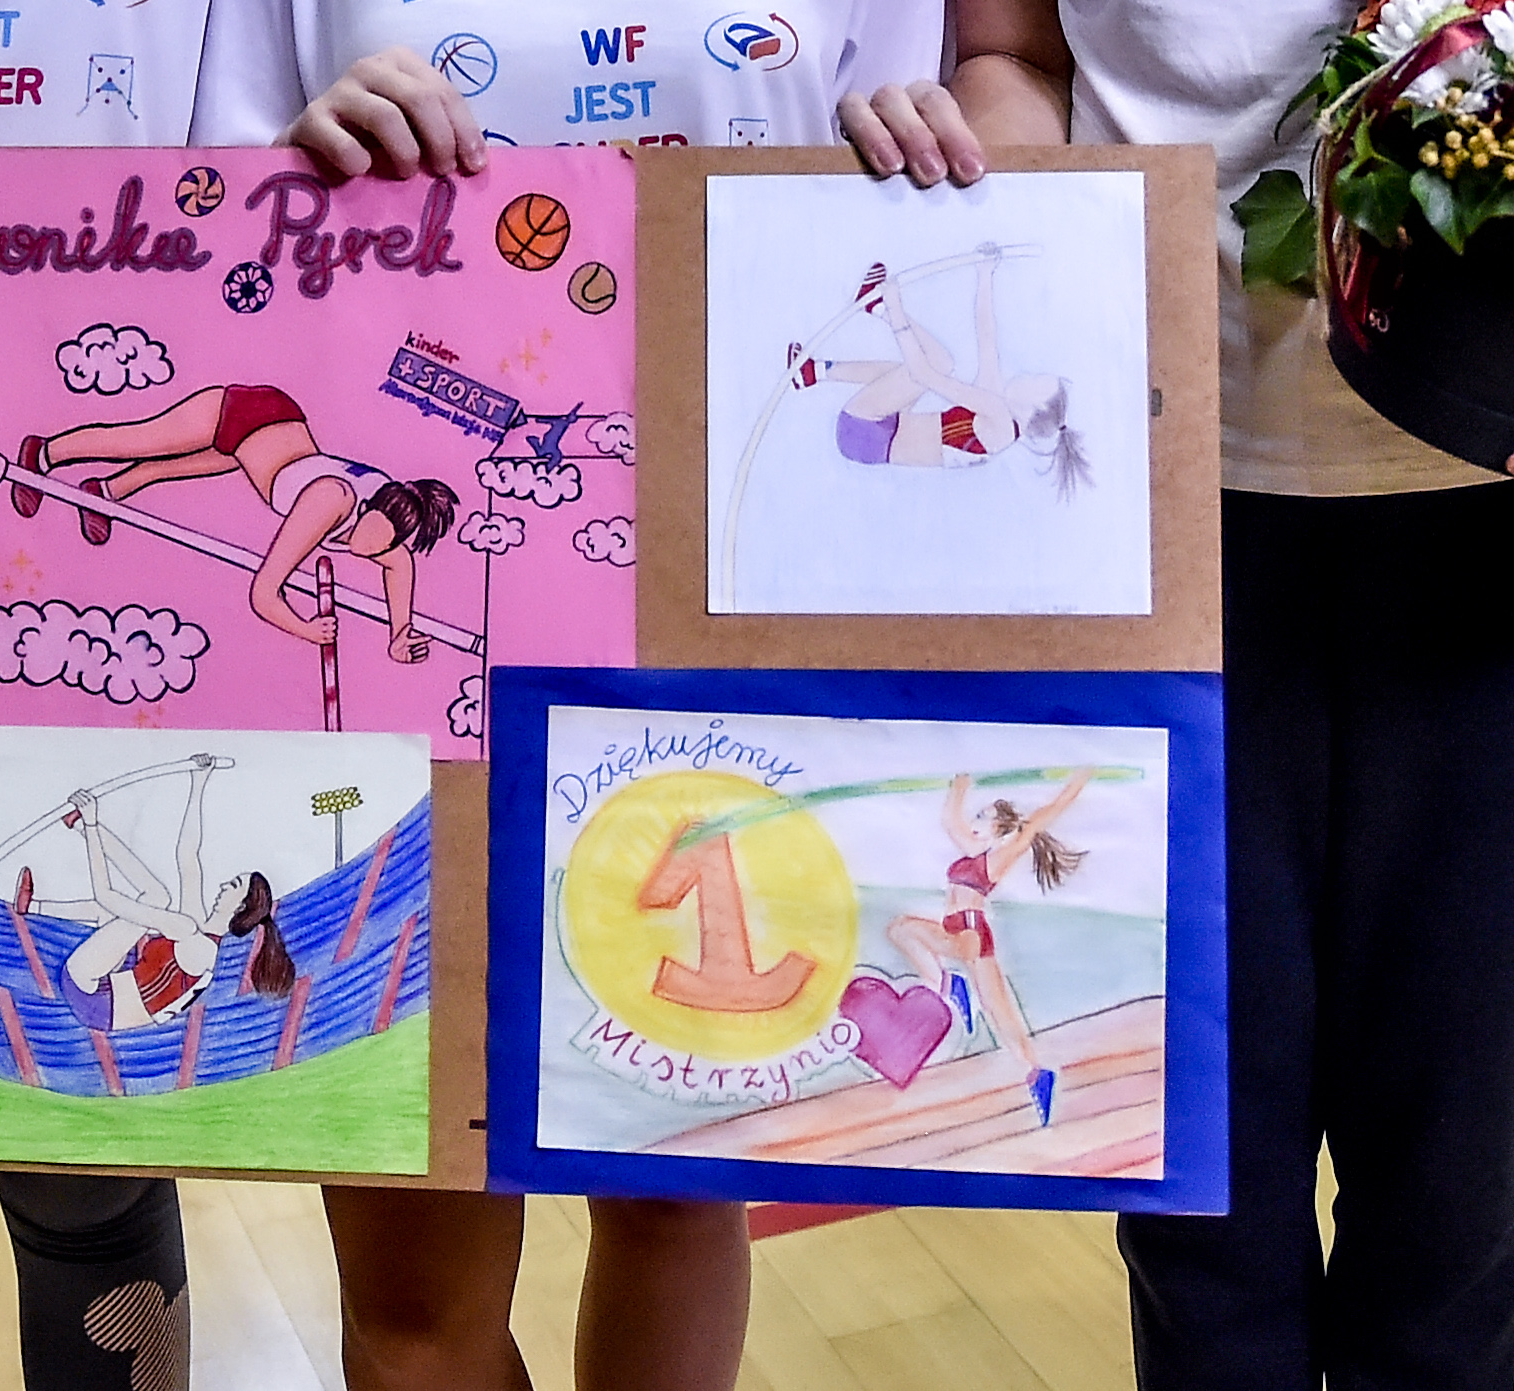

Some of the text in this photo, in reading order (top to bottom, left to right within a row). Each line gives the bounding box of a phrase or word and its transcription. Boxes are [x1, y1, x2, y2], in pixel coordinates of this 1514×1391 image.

[580, 25, 647, 66] WF
[565, 80, 656, 124] JEST
[244, 170, 463, 300] Pyrek
[405, 330, 460, 365] kinder
[553, 718, 804, 824] Dziękujemy
